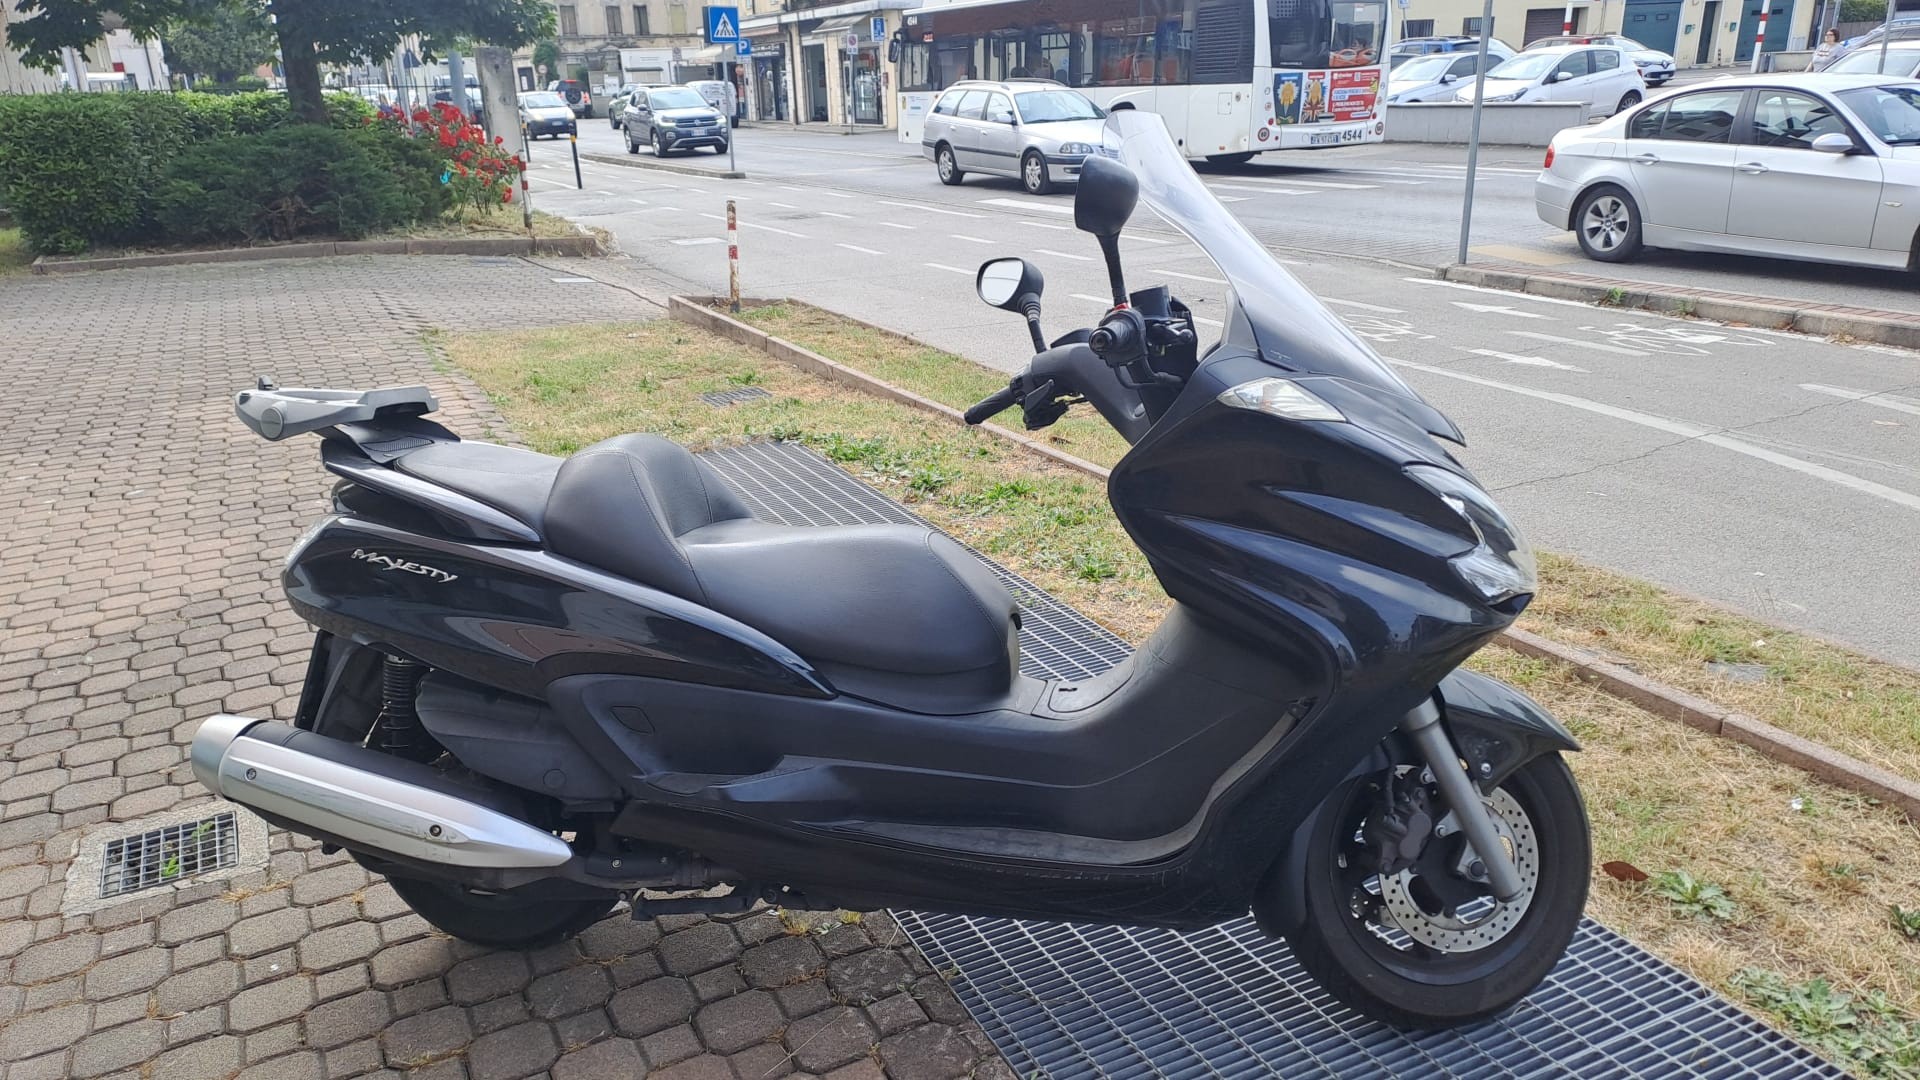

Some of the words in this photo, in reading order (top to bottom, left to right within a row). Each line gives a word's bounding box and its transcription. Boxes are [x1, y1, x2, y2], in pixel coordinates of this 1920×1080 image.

[738, 40, 748, 54] P
[1341, 129, 1362, 142] 4544
[350, 548, 459, 583] MAJESTY
